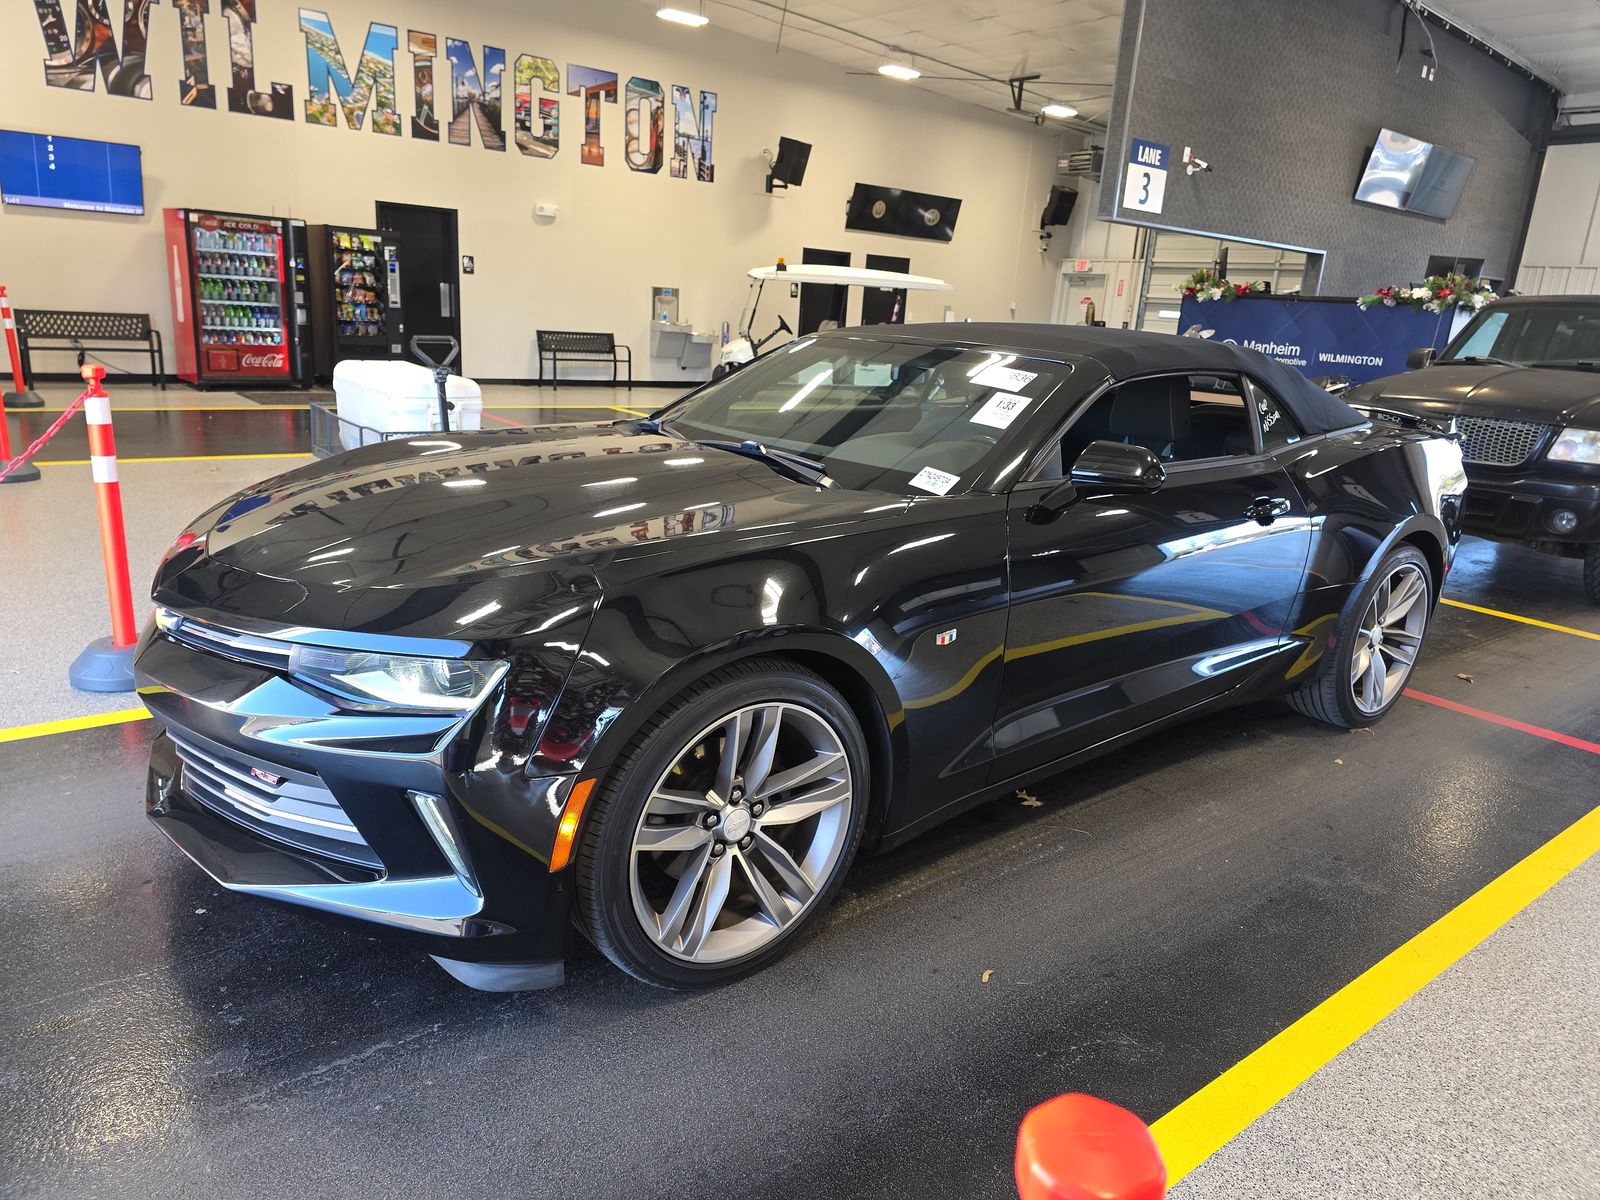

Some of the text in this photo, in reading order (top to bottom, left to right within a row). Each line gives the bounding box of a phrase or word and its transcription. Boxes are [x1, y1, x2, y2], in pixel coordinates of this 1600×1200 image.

[34, 0, 718, 183] WILMINGTON
[47, 144, 54, 152] 2
[1137, 145, 1162, 166] LANE
[48, 153, 55, 161] 3
[48, 163, 56, 171] 4
[1138, 172, 1151, 205] 3
[1243, 339, 1301, 356] Manheim
[1318, 352, 1384, 367] WILMINGTON
